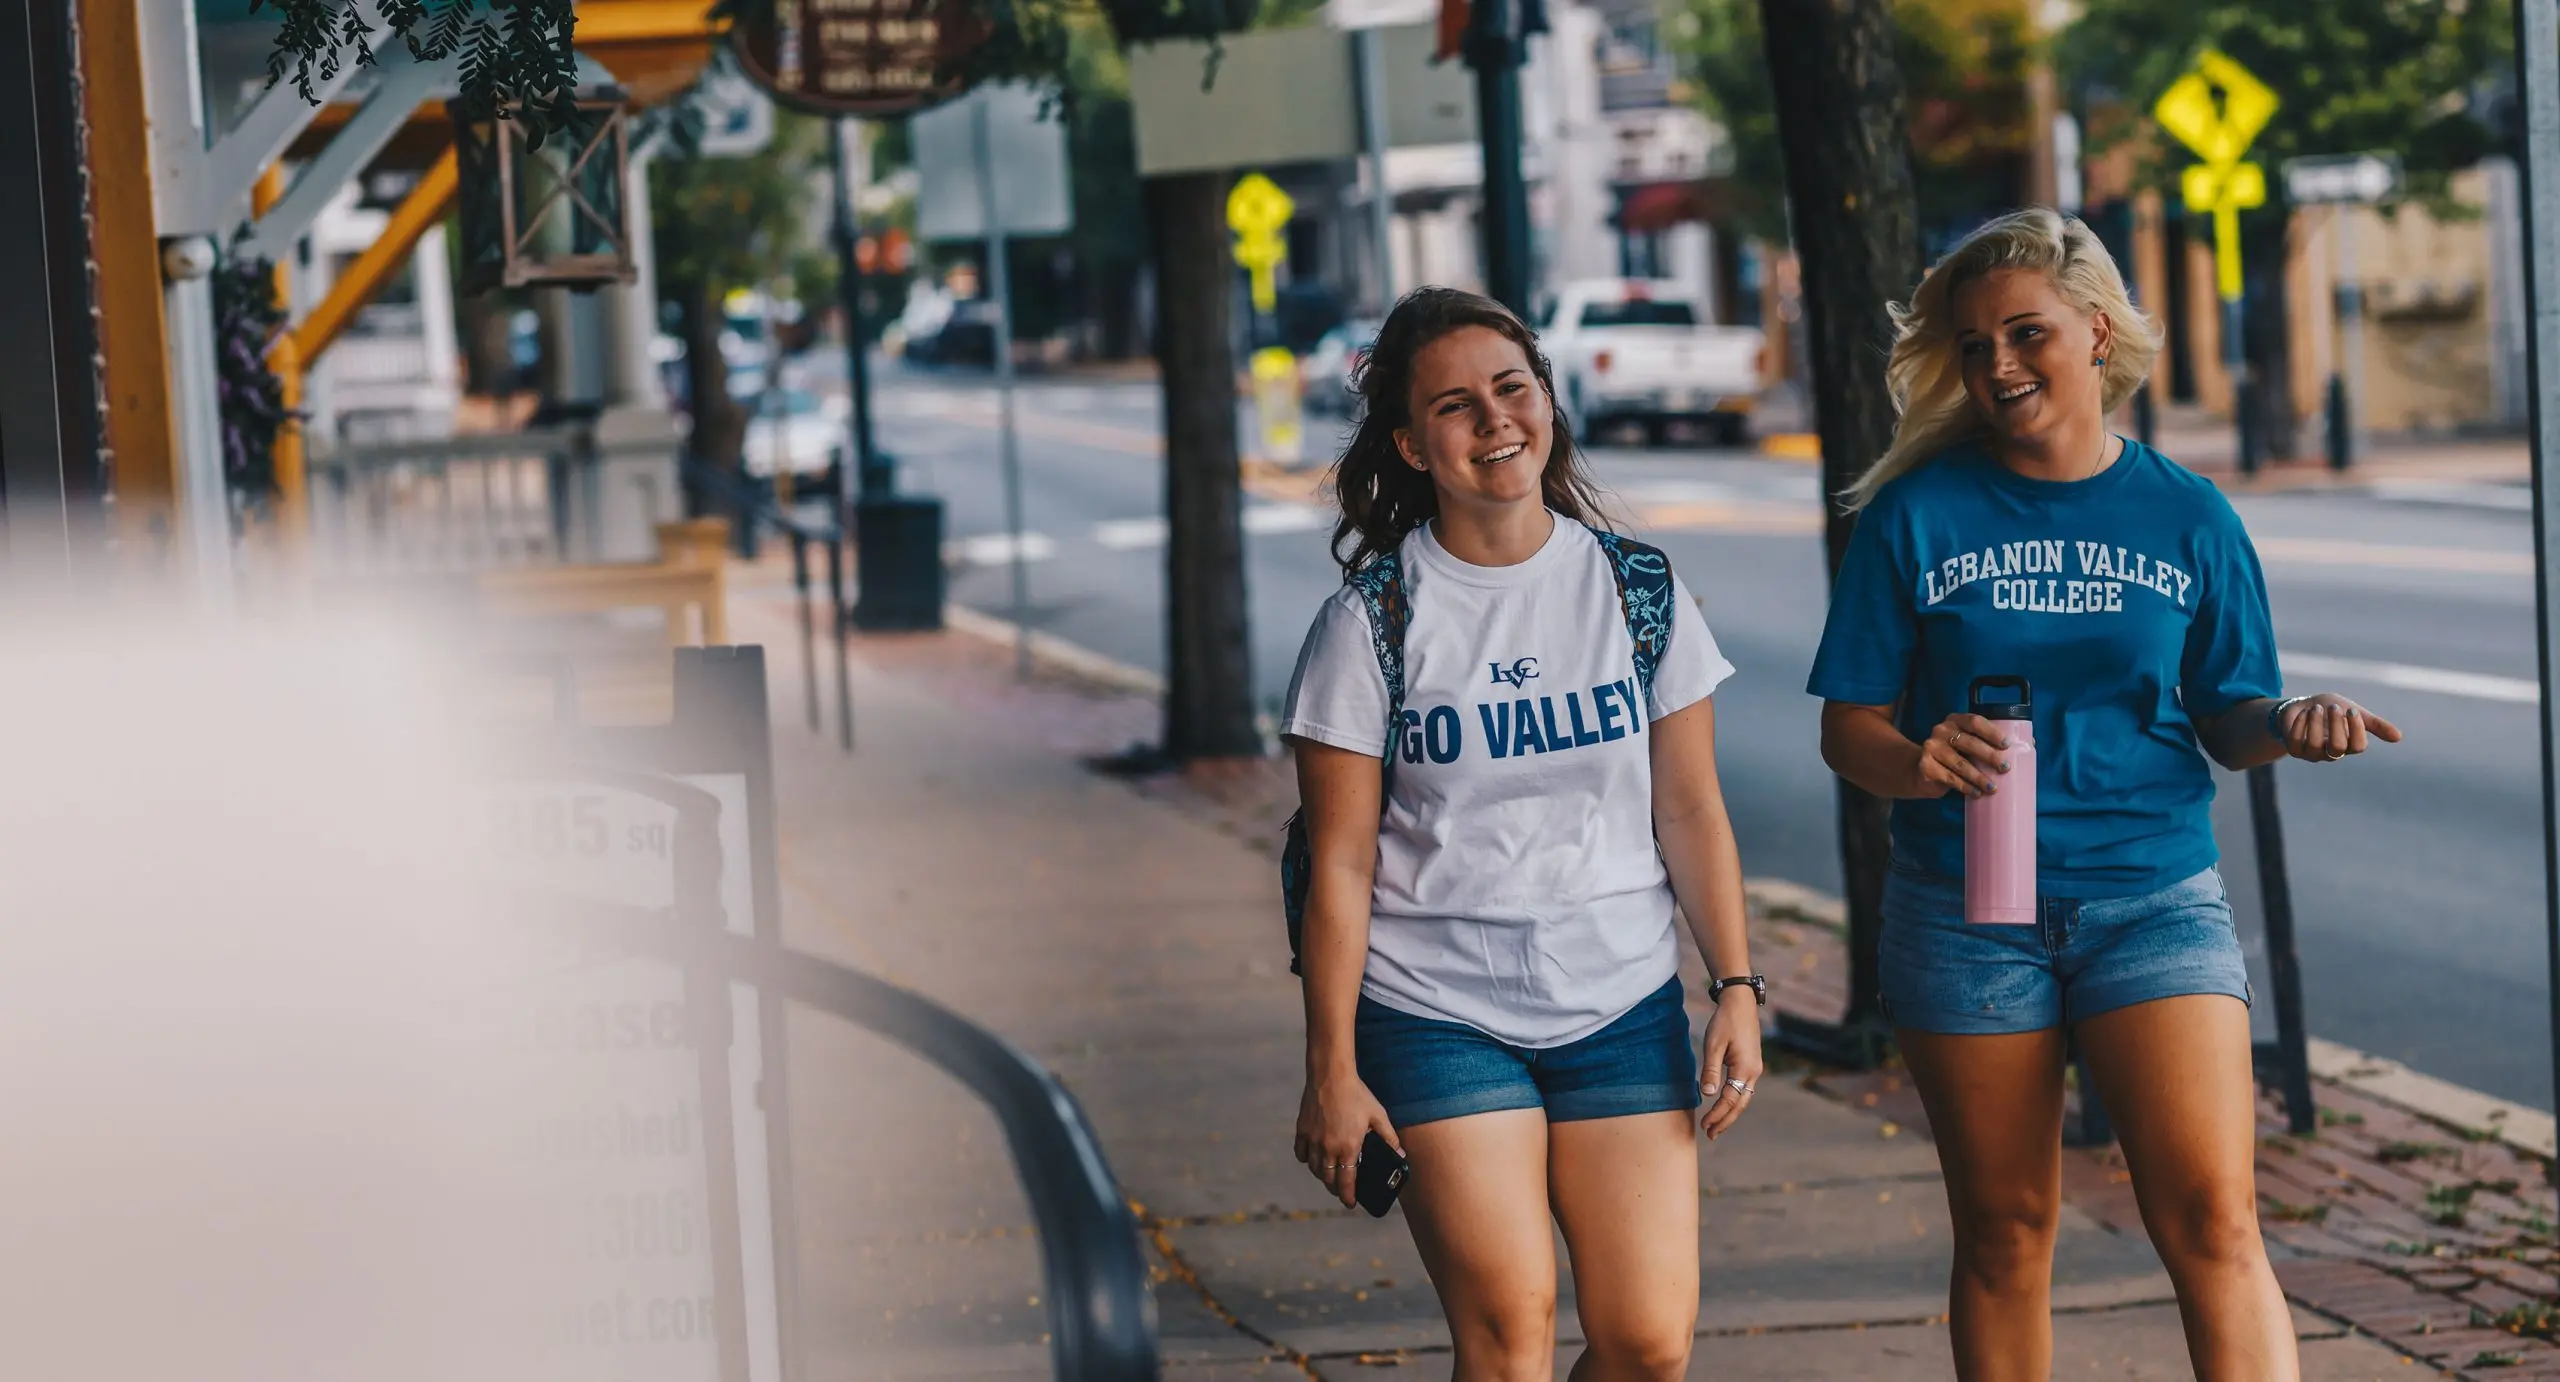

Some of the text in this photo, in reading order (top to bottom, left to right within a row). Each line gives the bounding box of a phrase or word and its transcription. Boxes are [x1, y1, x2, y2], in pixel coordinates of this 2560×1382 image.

[1926, 540, 2191, 607] LEBANON VALLEY
[1993, 579, 2122, 613] COLLEGE
[1488, 657, 1540, 690] LVC
[1401, 677, 1640, 764] GO VALLEY
